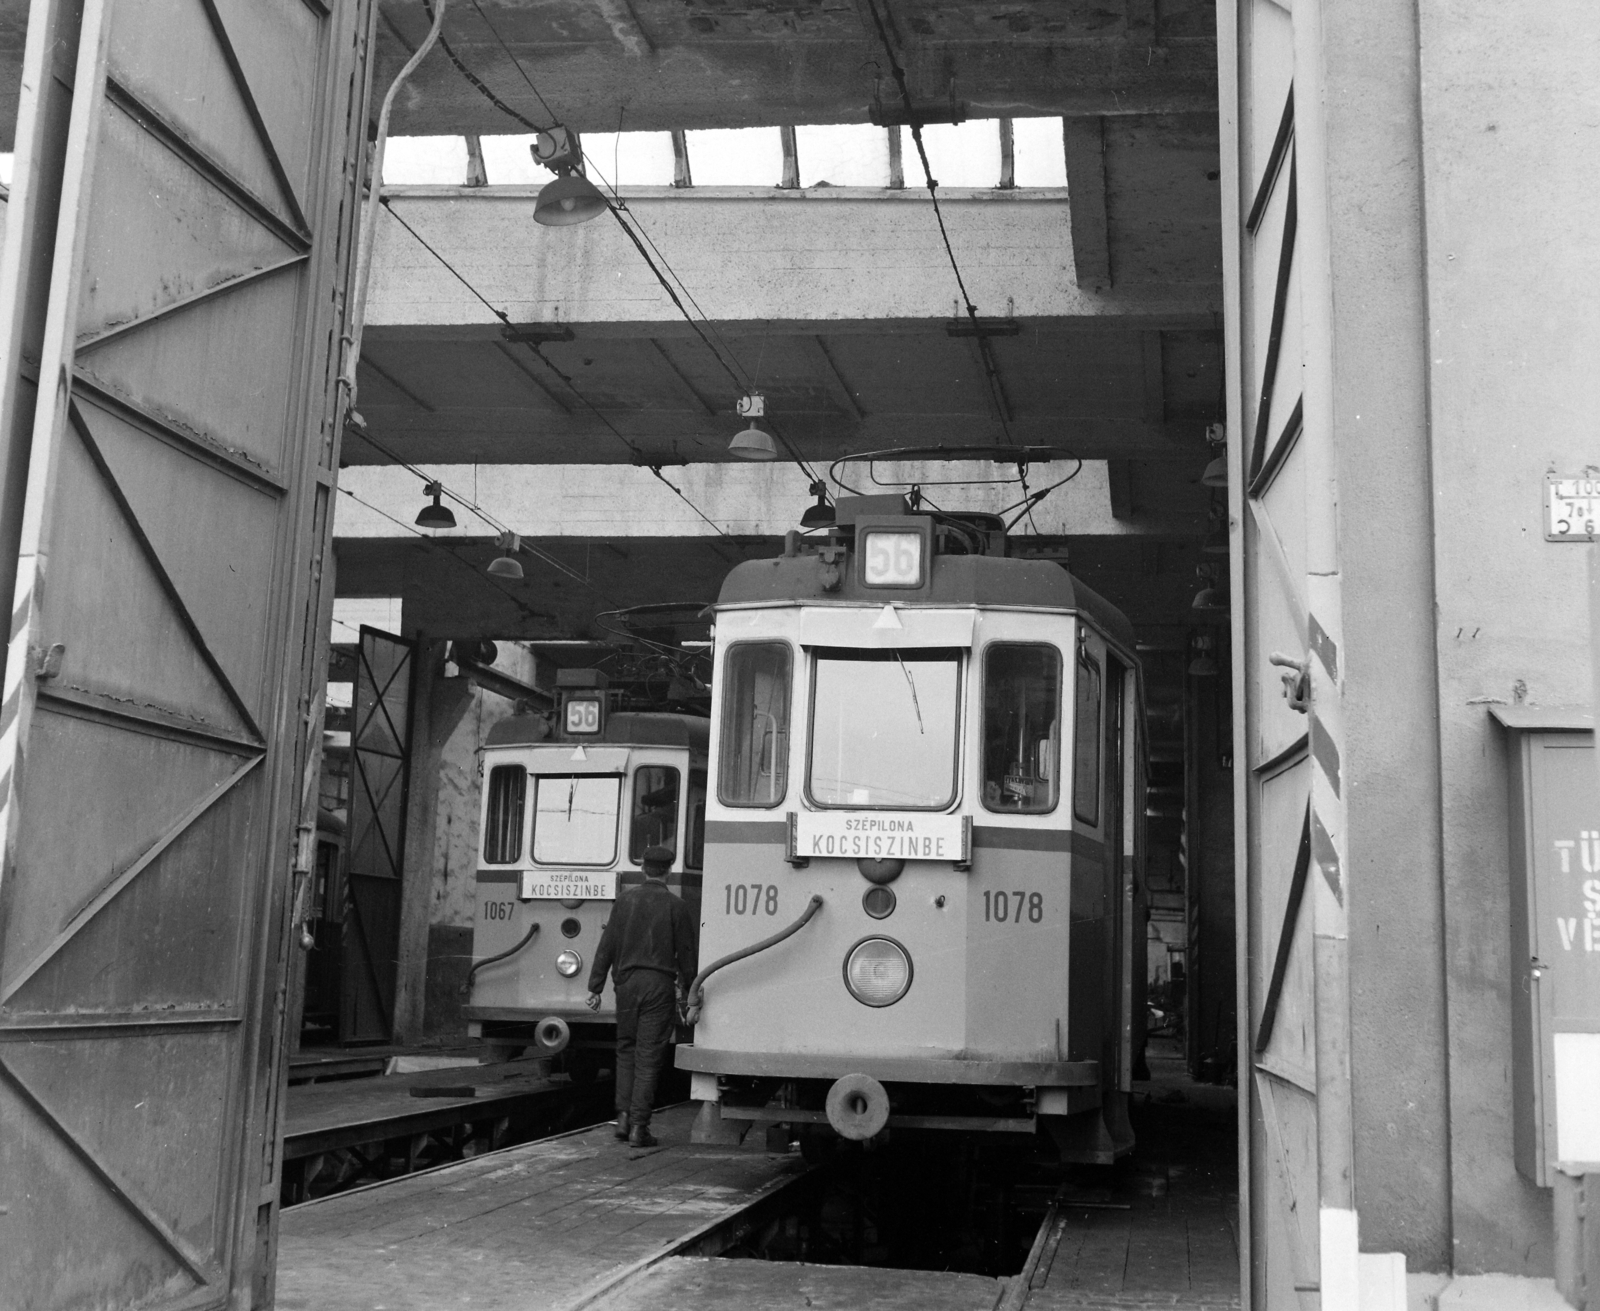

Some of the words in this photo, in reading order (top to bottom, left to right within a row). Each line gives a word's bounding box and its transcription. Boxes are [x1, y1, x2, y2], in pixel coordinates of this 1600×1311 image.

[869, 535, 916, 577] 56
[570, 701, 597, 728] 56
[846, 816, 914, 832] SZÉPILONA
[812, 834, 945, 857] KOCSISZINBE
[531, 884, 606, 897] KOCSISZINBE
[725, 883, 779, 916] 1078
[484, 901, 515, 921] 1067
[983, 889, 1043, 924] 1078
